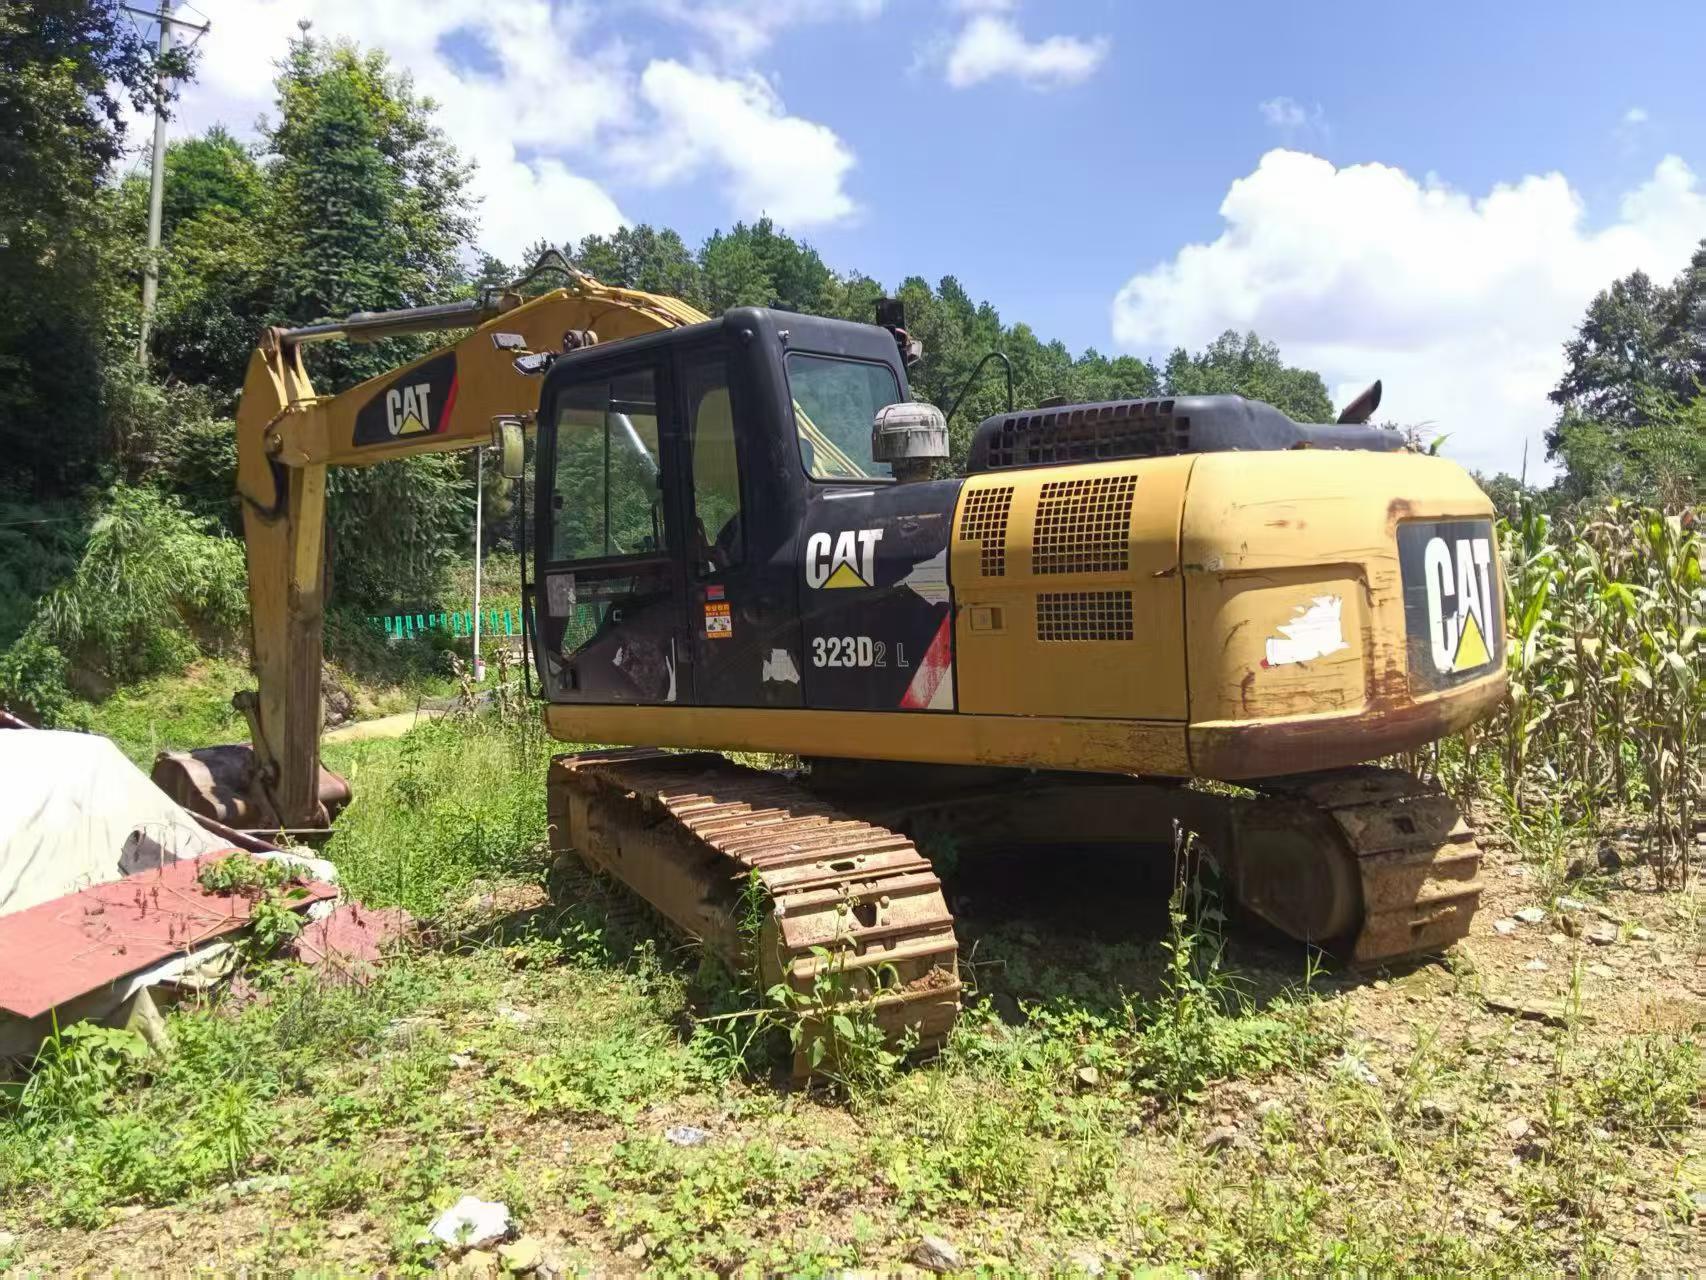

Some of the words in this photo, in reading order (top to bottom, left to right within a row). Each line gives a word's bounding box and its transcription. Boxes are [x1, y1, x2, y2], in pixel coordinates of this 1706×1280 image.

[386, 383, 431, 435] CAT
[805, 528, 884, 589] CAT
[1424, 537, 1495, 673] CAT
[812, 636, 886, 668] 323D2
[896, 642, 909, 667] L
